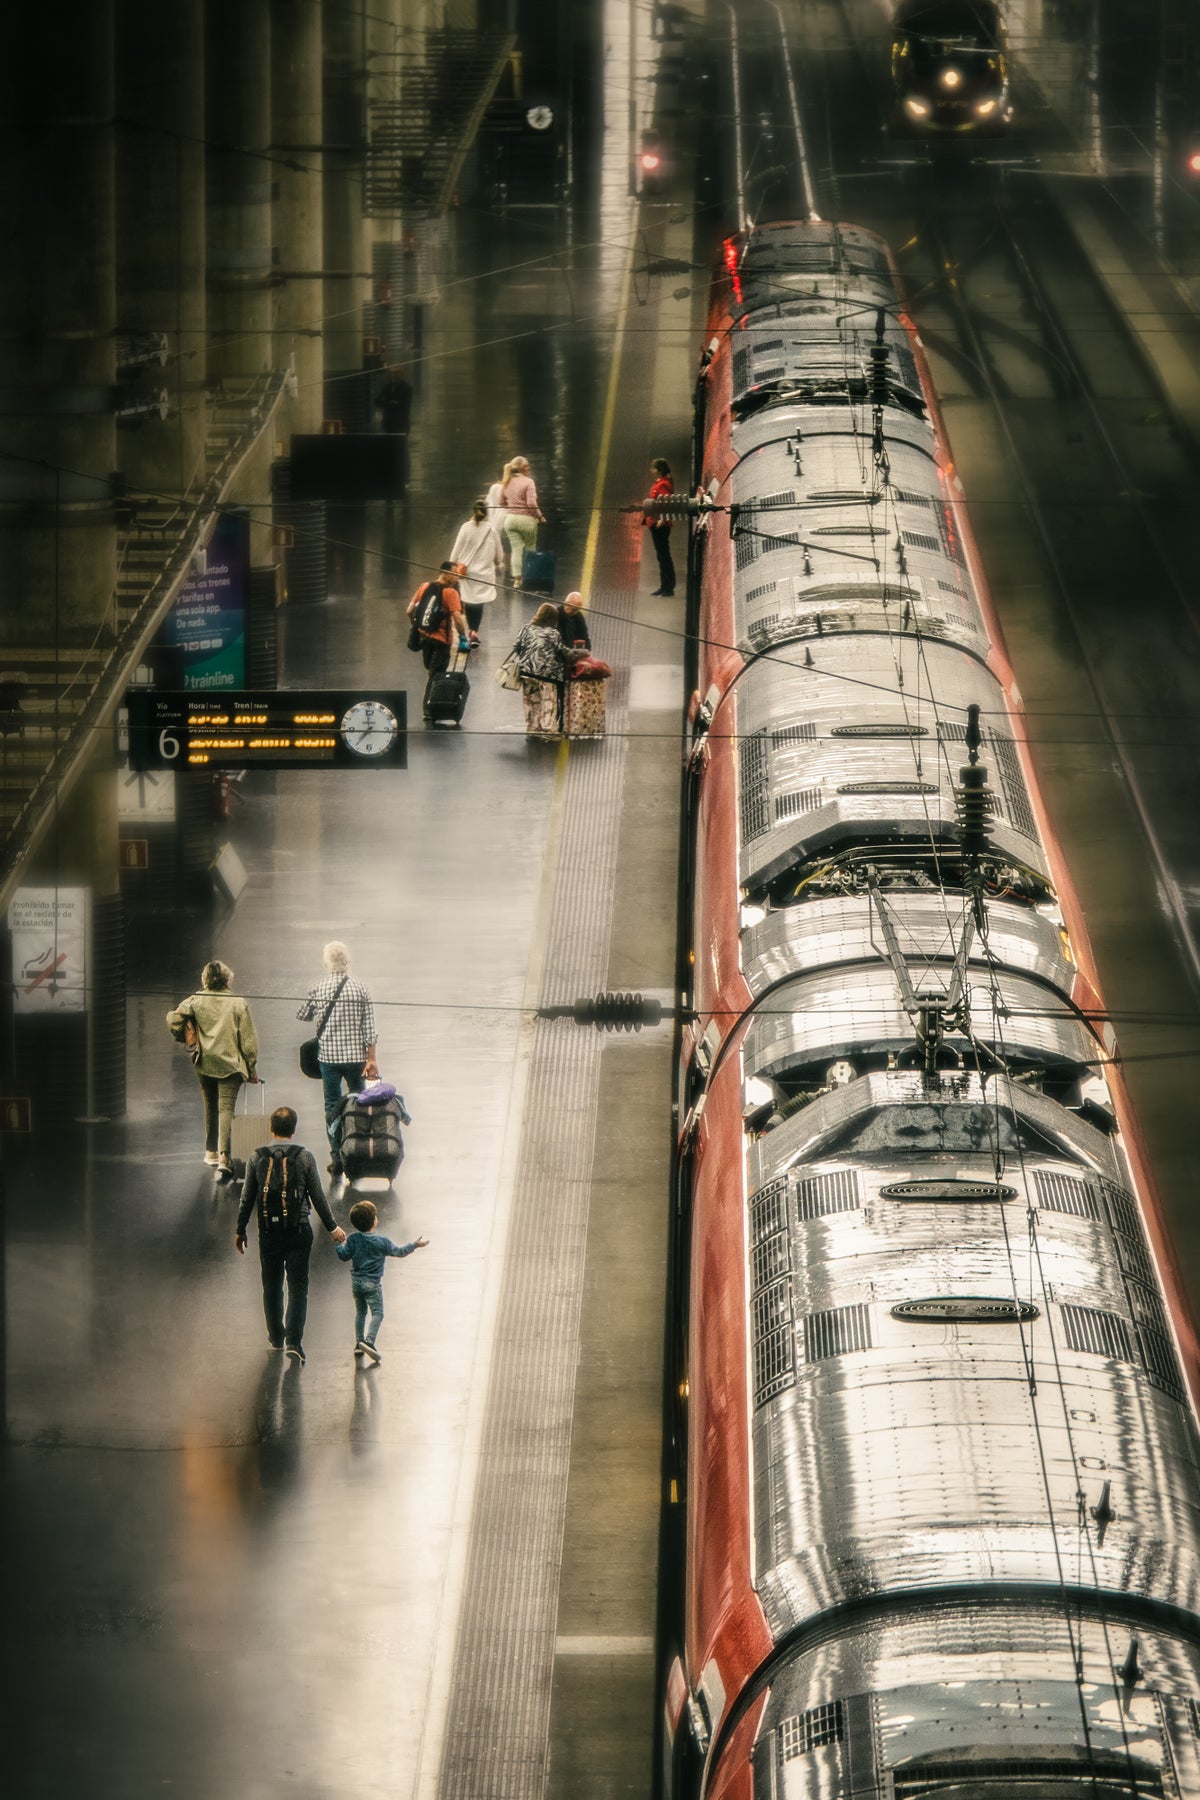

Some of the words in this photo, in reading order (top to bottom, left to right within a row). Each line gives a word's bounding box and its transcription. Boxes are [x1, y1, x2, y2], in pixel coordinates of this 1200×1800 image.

[191, 604, 206, 614] sola
[176, 618, 187, 628] De
[191, 672, 234, 689] trainline
[234, 702, 250, 710] Tren
[159, 725, 180, 760] 6
[13, 902, 50, 910] Prohibido
[23, 919, 53, 927] estación
